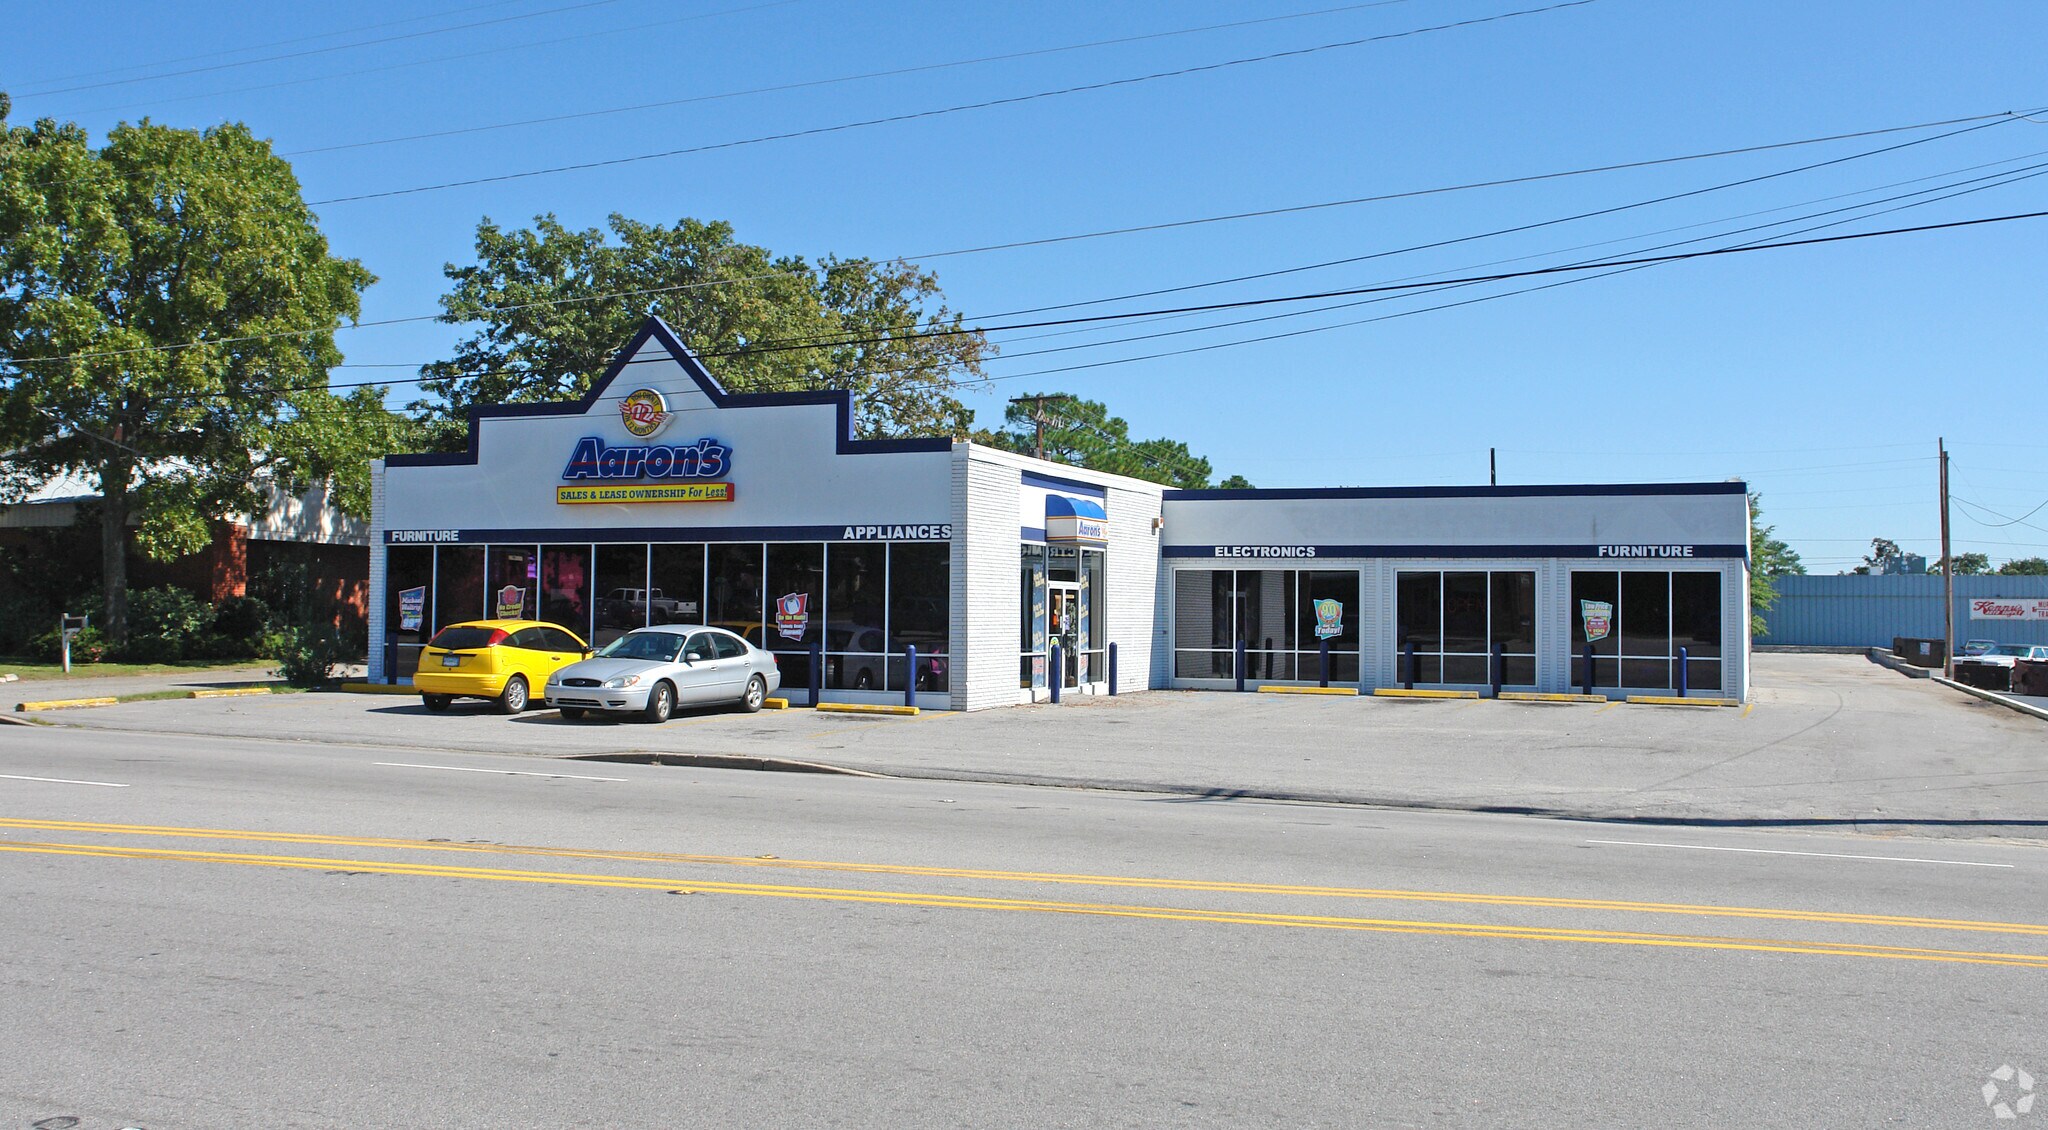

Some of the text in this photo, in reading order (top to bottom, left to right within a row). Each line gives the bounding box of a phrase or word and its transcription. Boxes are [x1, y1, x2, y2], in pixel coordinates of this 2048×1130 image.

[634, 422, 657, 434] MONTHS
[562, 437, 730, 480] Aaron's
[560, 486, 728, 500] SALES & LEASE OWNERSHIP For Less!
[391, 530, 459, 542] FURNITURE
[843, 525, 952, 540] APPLIANCES
[1214, 546, 1316, 558] ELECTRONICS
[1598, 545, 1693, 558] FURNITURE
[1322, 604, 1336, 617] 90
